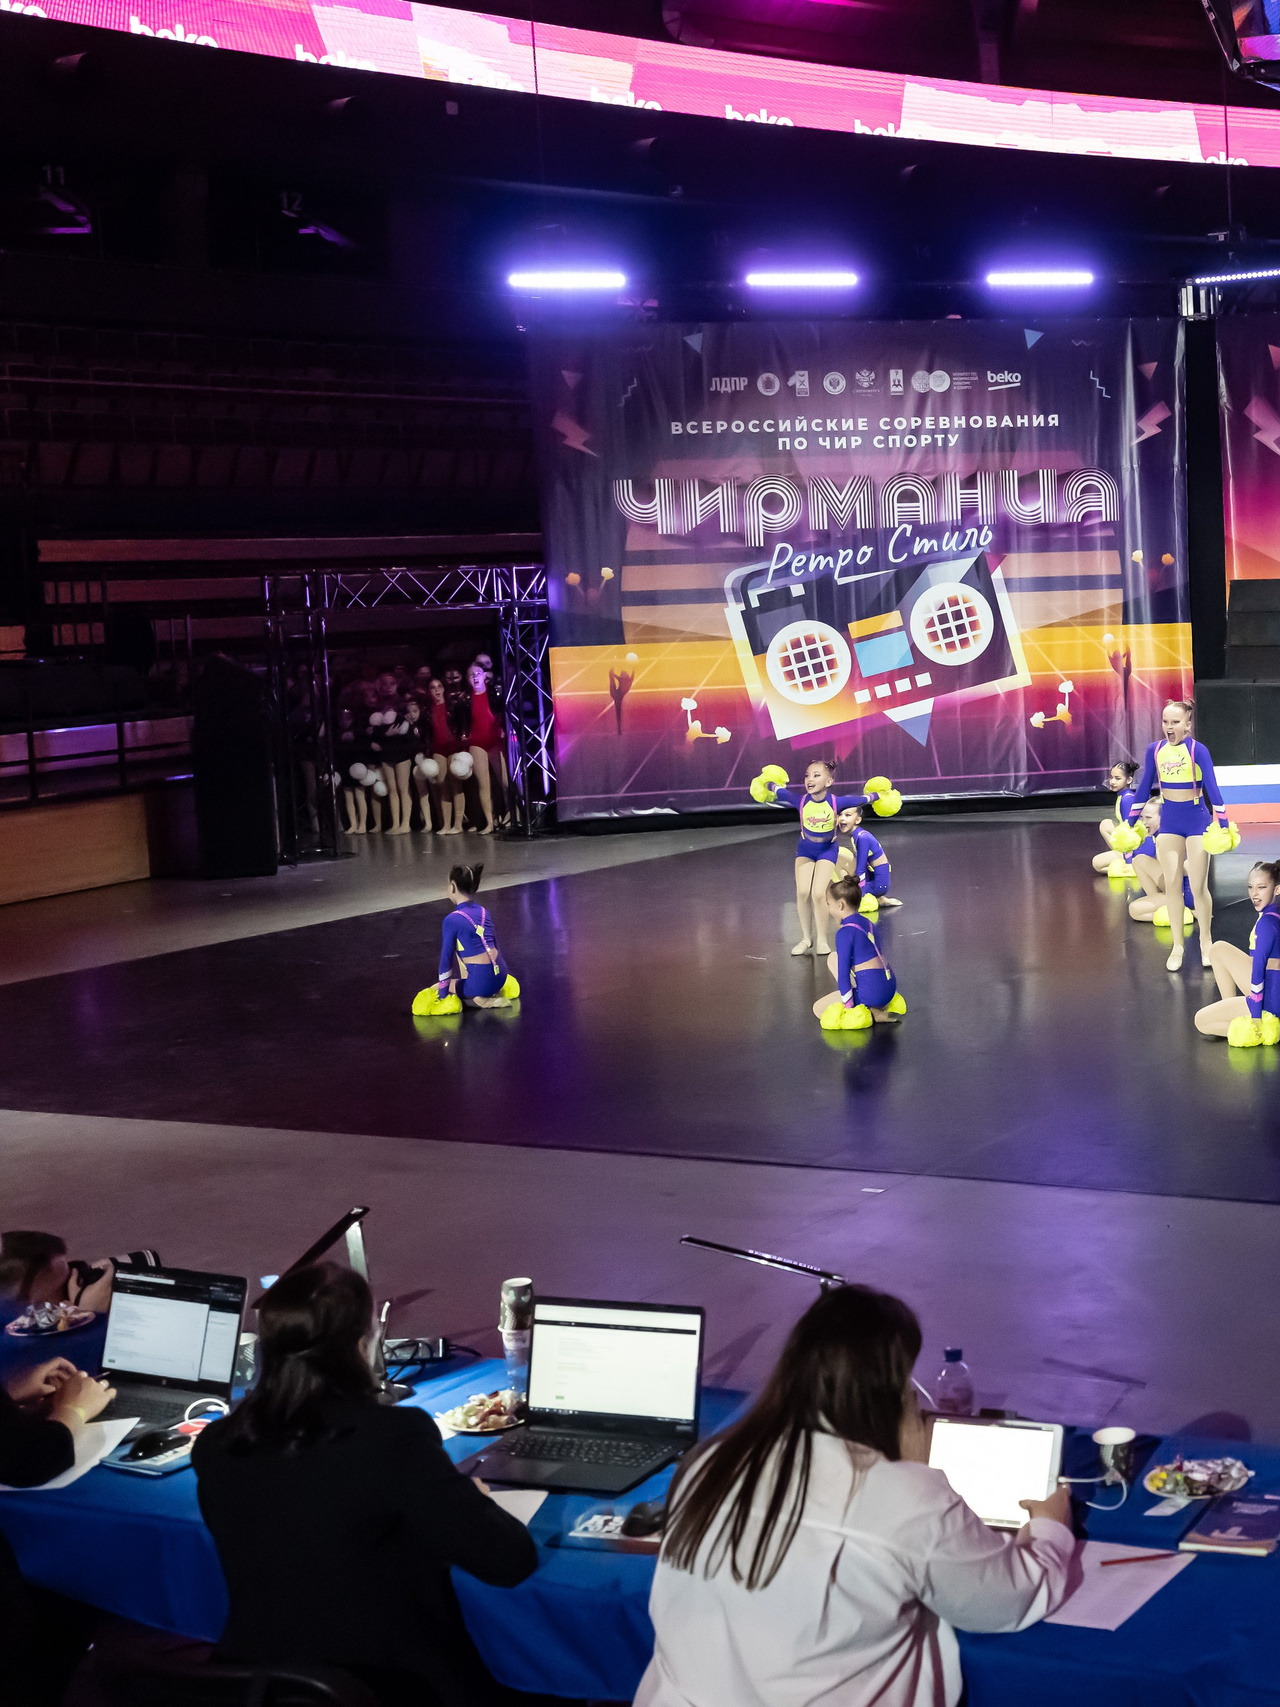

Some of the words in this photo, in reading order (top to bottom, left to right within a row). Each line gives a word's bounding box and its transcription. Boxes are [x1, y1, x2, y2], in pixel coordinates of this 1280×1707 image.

[710, 377, 749, 393] ЛДПР
[986, 370, 1022, 383] beko
[670, 416, 869, 435] ВСЕРОССИЙСКИЕ
[878, 414, 1061, 431] СОРЕВНОВАНИЯ
[778, 436, 808, 450] ПО
[818, 435, 863, 450] ЧИР
[872, 433, 960, 448] СПОРТУ
[766, 542, 873, 585] Ретро
[887, 523, 994, 563] Стиль
